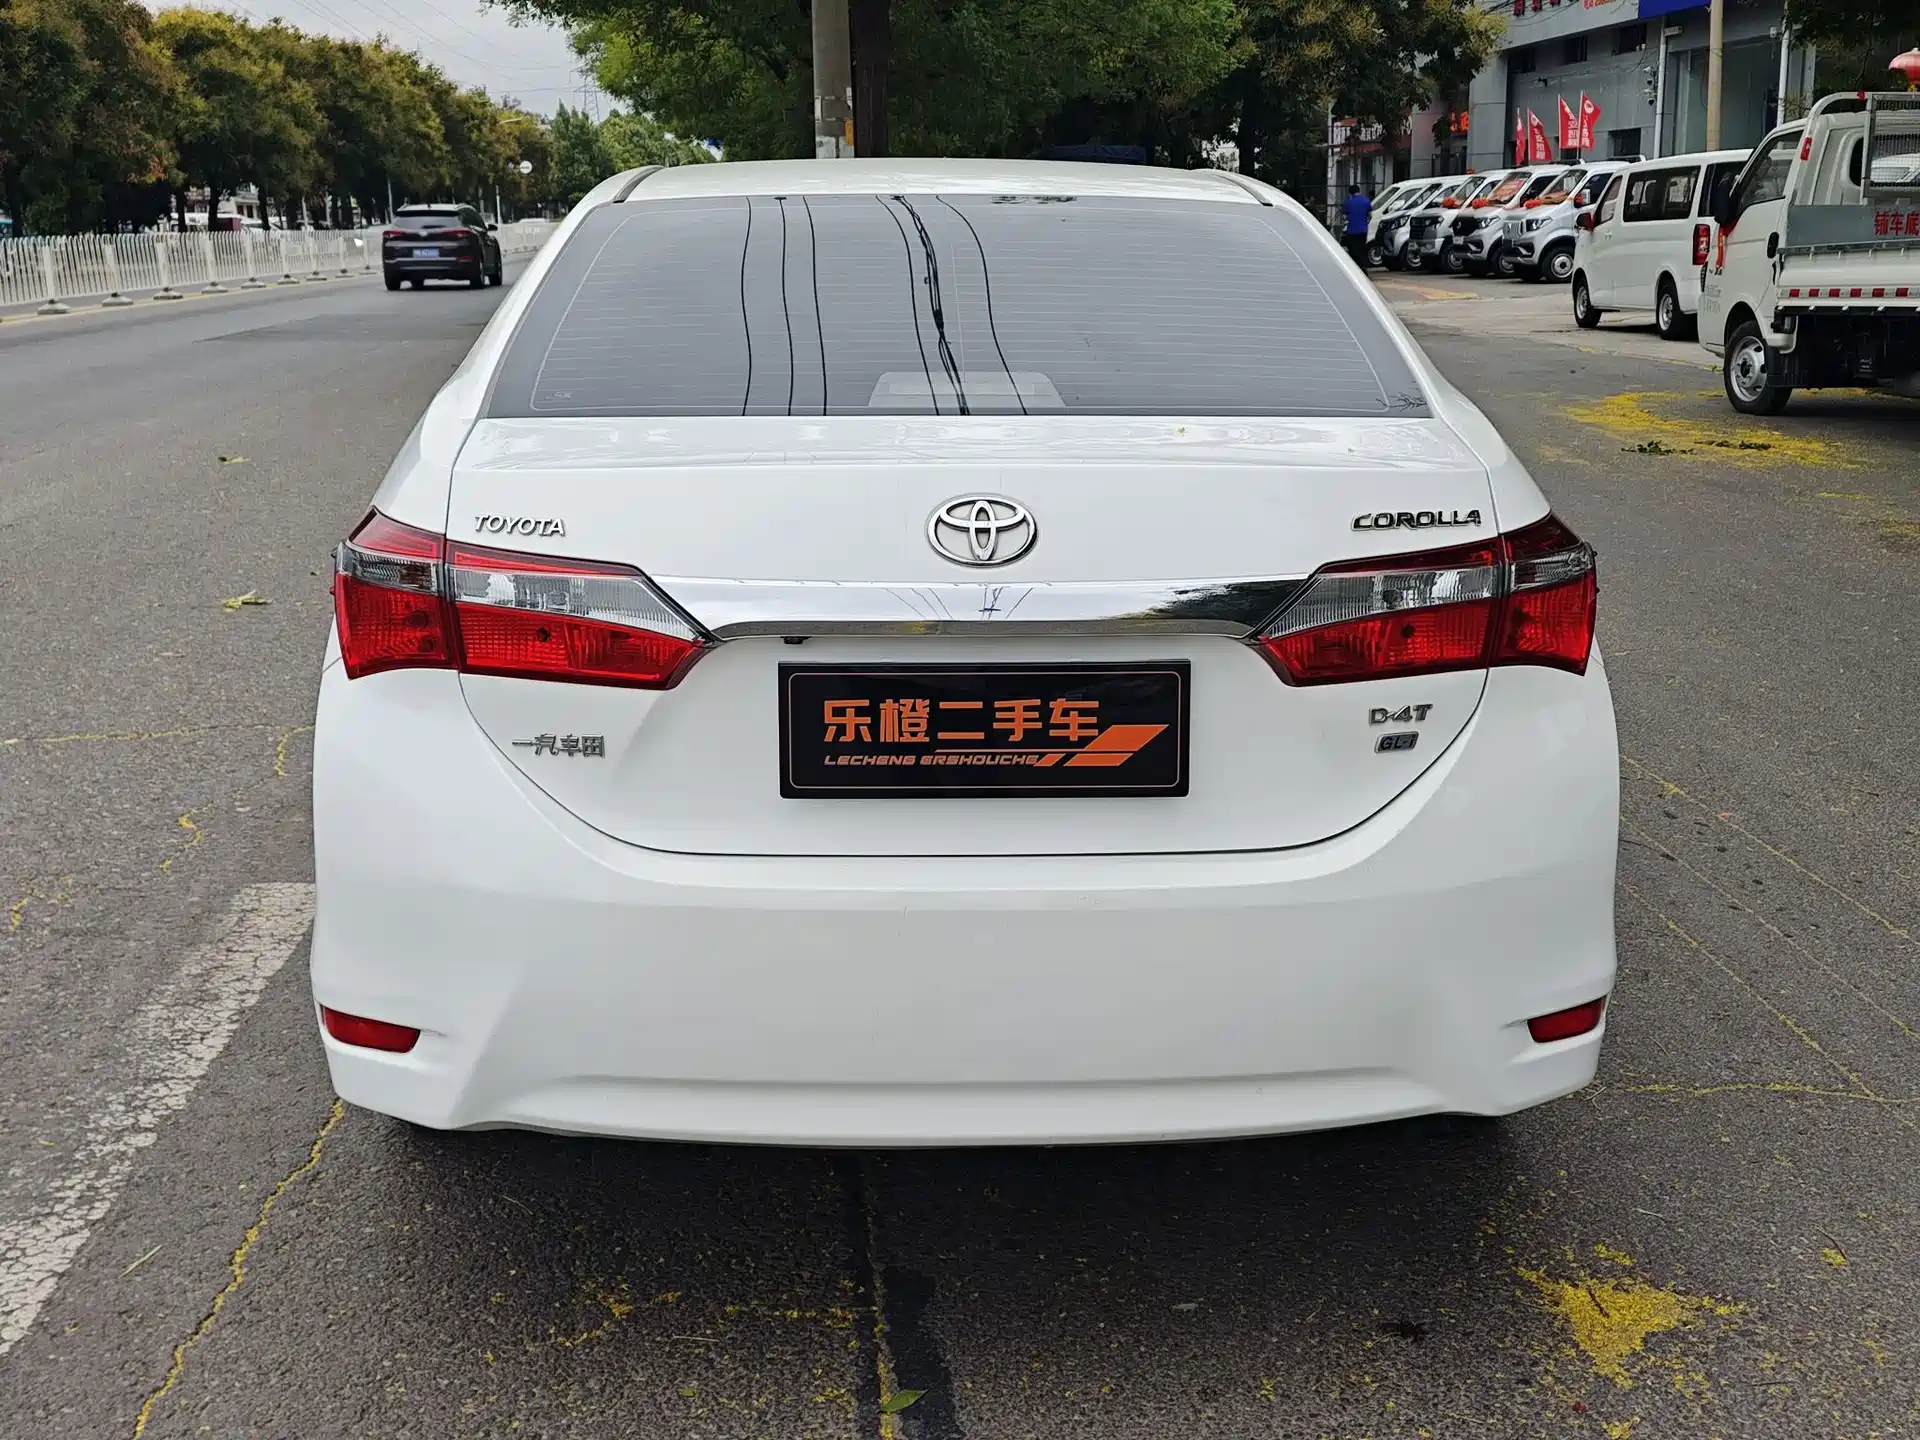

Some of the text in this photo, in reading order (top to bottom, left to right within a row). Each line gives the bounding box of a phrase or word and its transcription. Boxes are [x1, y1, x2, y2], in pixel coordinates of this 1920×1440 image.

[475, 514, 565, 537] TOYOTA
[1352, 508, 1482, 531] COROLLA
[823, 698, 1099, 743] 乐橙二手车
[823, 753, 1039, 766] LECHENG ERSHOUCHE
